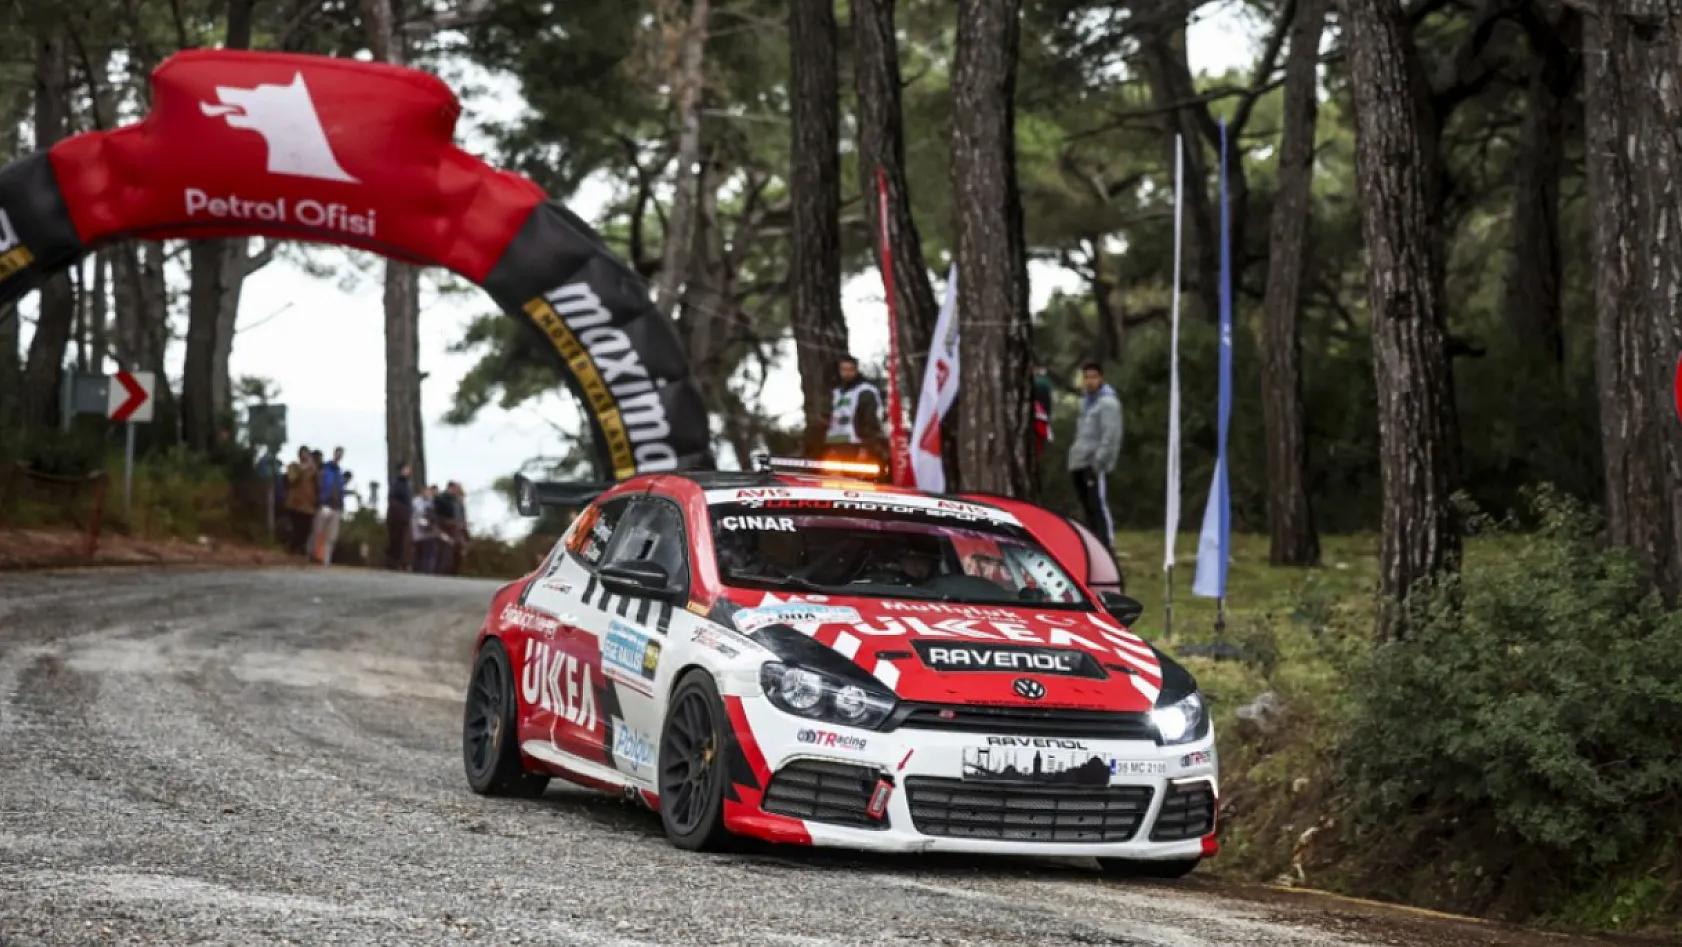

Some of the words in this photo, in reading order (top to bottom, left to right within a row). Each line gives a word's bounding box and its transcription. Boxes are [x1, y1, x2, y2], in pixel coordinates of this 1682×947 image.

[184, 187, 286, 222] Petrol
[294, 199, 377, 237] Ofisi
[543, 282, 679, 474] maxima
[736, 489, 791, 498] AVIS
[937, 500, 989, 516] AVIS
[928, 648, 1073, 672] RAVENOL
[986, 735, 1090, 752] RAVENOL
[1130, 761, 1146, 774] MC
